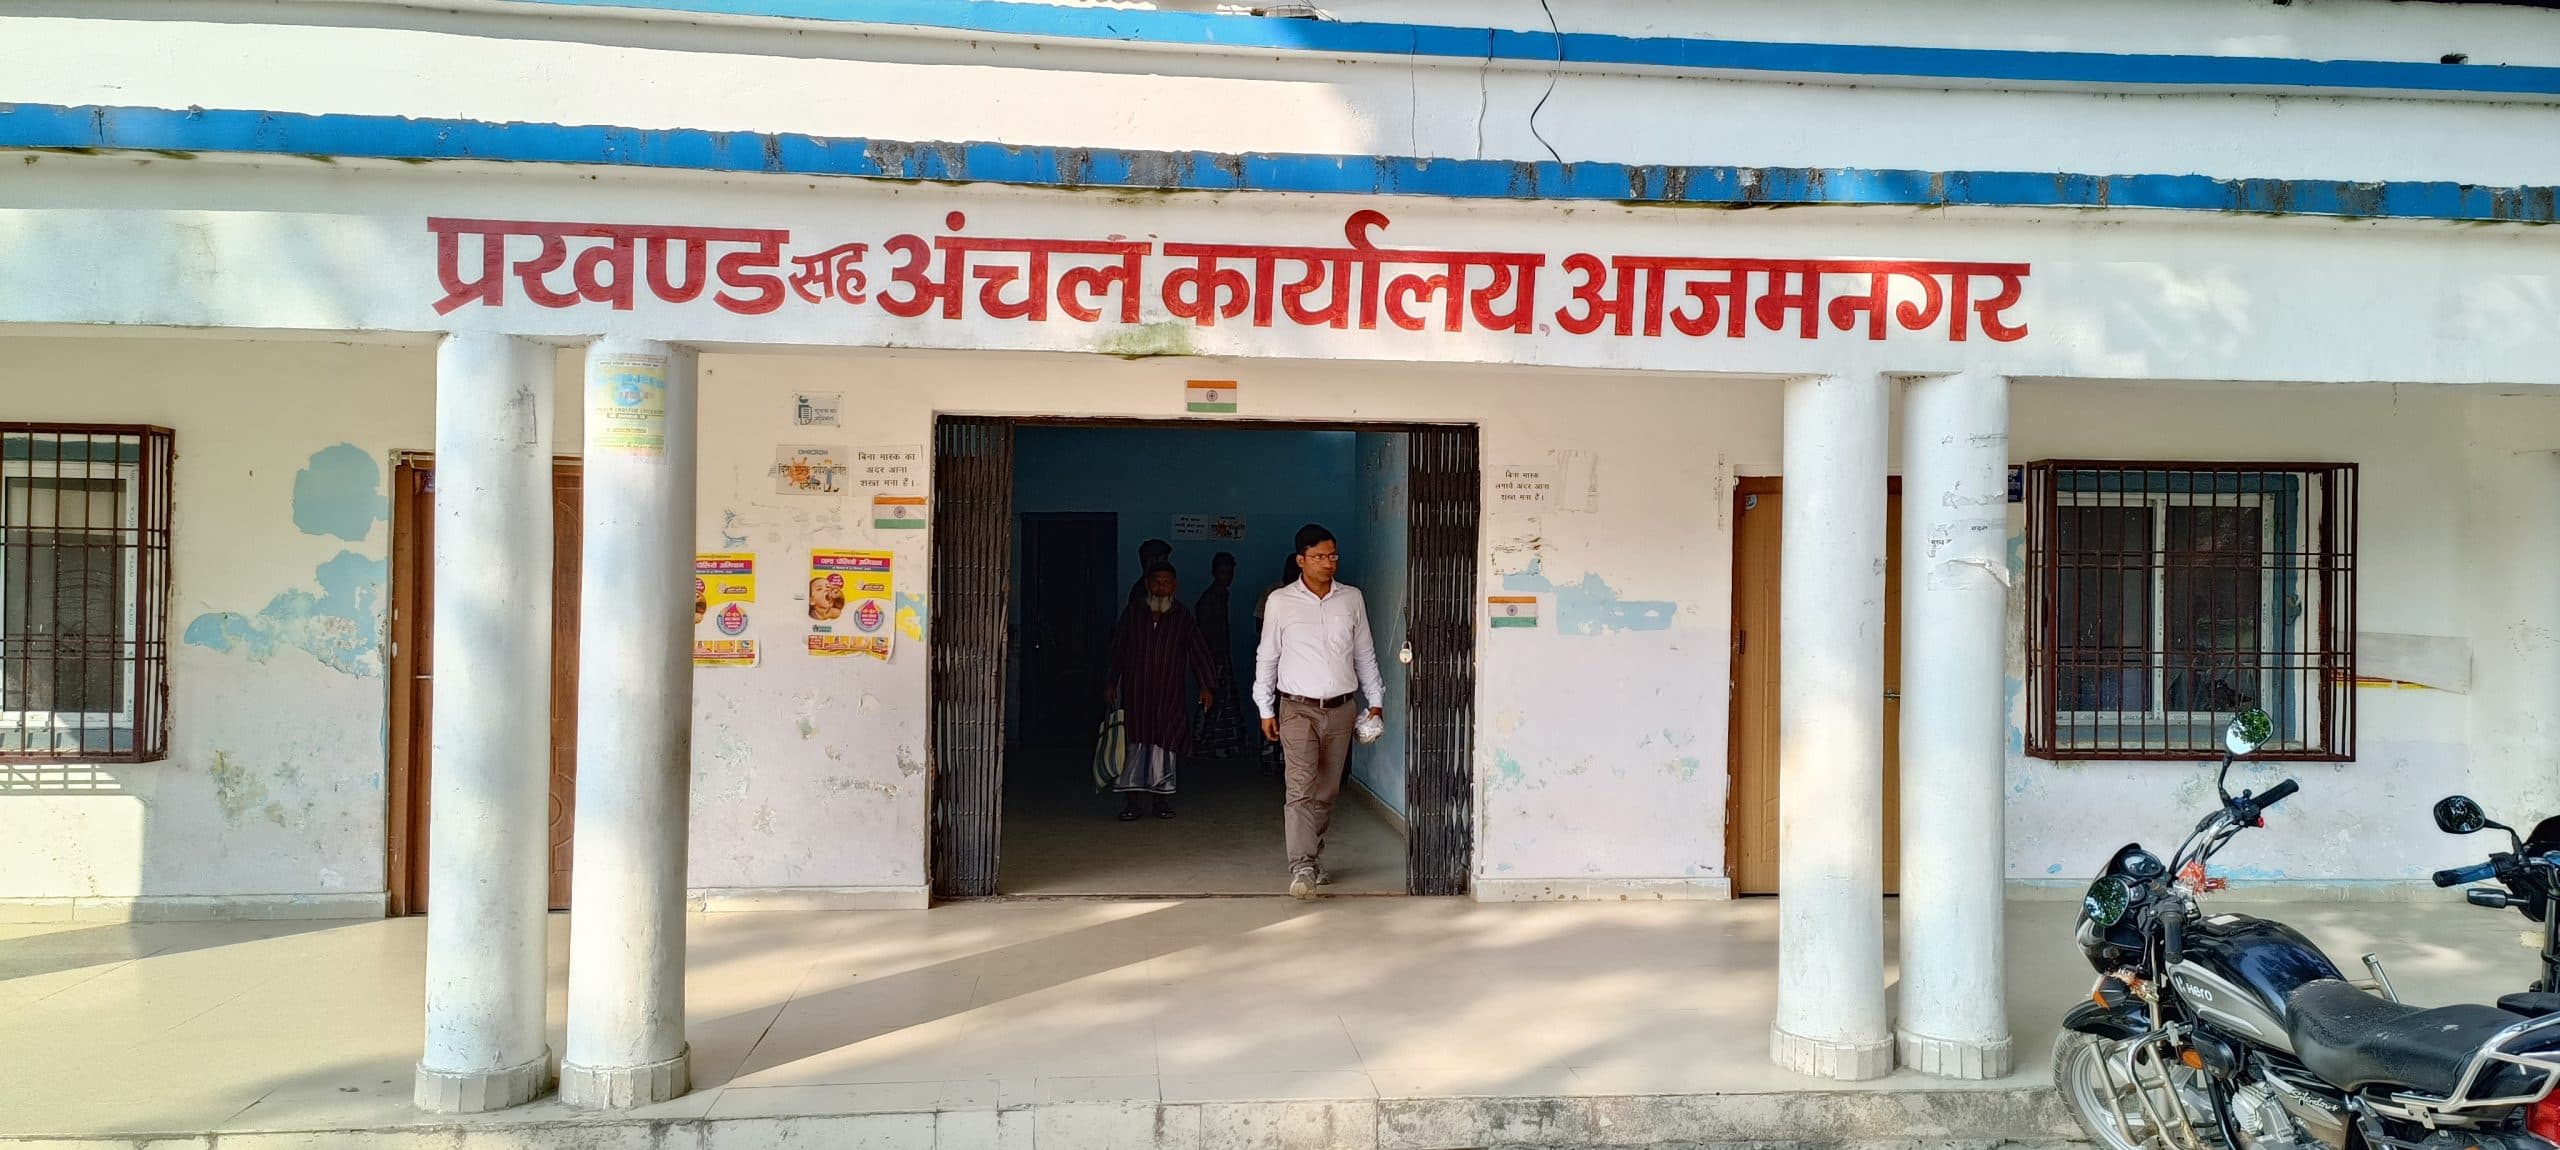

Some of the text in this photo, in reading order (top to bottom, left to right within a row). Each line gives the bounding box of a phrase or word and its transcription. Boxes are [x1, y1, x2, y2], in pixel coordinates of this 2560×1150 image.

[430, 209, 2031, 342] प्रखण्ड सह अंचल कार्यालय आजमनगर
[858, 452, 876, 461] बिना
[904, 453, 916, 461] का
[2185, 982, 2213, 1002] Hero
